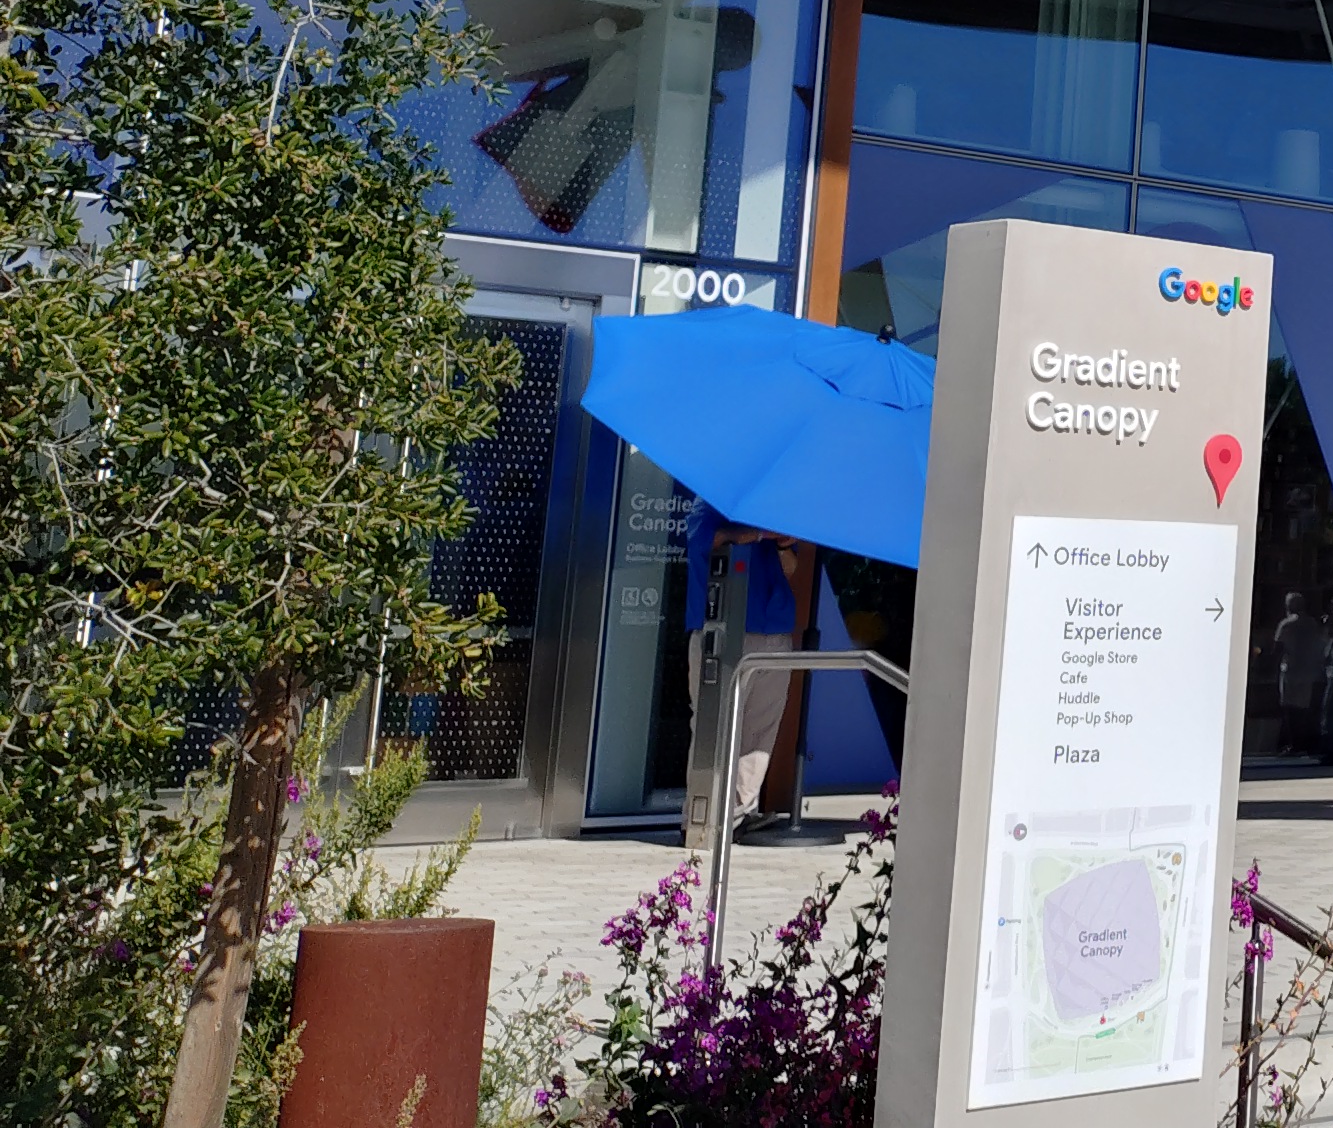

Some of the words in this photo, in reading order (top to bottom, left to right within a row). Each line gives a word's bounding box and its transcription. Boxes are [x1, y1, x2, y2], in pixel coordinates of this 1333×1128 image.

[652, 265, 745, 305] 2000
[1158, 267, 1254, 312] Google
[1031, 341, 1181, 390] Gradient
[1026, 391, 1160, 444] Canopy
[629, 513, 689, 537] Canop
[1053, 546, 1111, 566] Office
[1116, 548, 1170, 573] Lobby
[1065, 597, 1124, 617] Visitor
[1063, 621, 1163, 645] Experience
[1061, 651, 1105, 668] Google
[1107, 651, 1139, 664] Store
[1059, 671, 1089, 685] Cafe
[1058, 691, 1101, 705] Huddle
[1056, 711, 1102, 729] Pop-Up
[1103, 710, 1134, 726] Shop
[1053, 745, 1101, 765] Plaza
[1078, 928, 1128, 943] Gradient
[1080, 944, 1124, 958] Canopy
